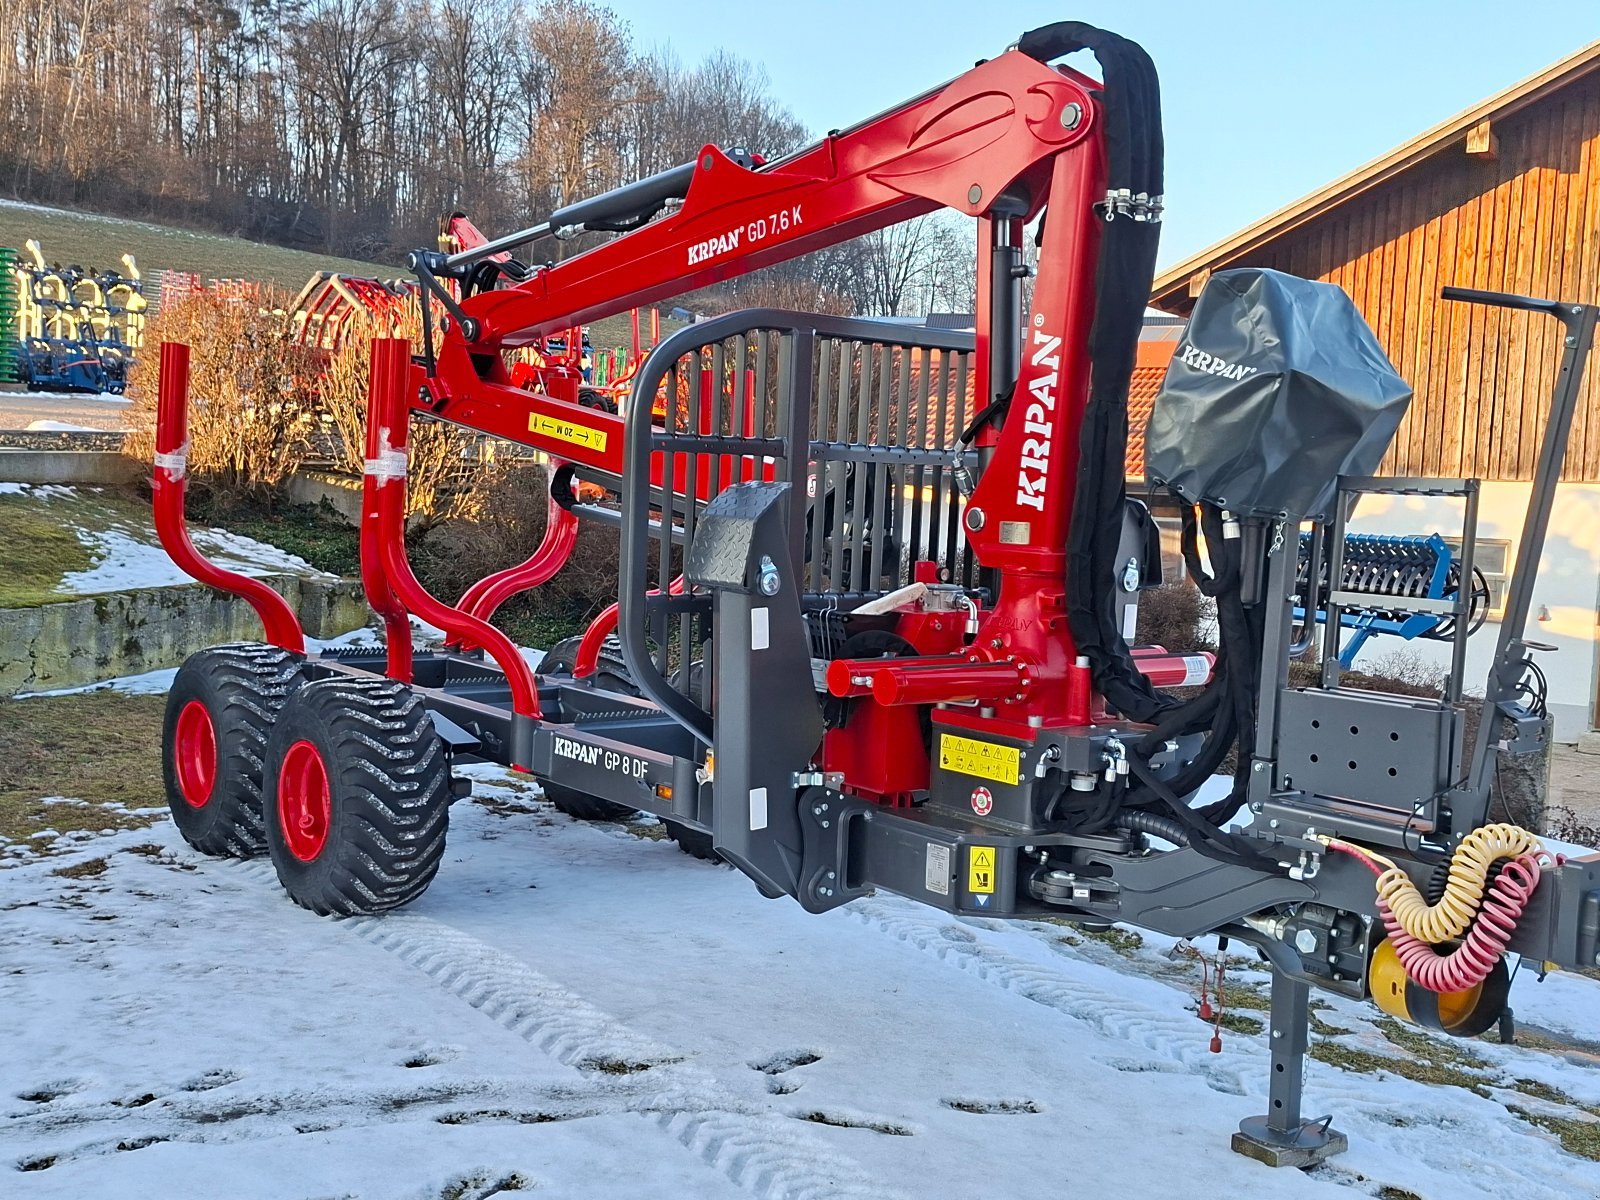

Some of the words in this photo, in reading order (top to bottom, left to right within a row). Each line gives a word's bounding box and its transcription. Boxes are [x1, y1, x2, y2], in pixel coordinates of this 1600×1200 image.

[747, 219, 767, 243] GD
[769, 209, 790, 235] 7,6
[792, 204, 803, 226] K
[556, 424, 563, 434] M
[564, 427, 573, 437] 20
[604, 751, 621, 771] GP
[622, 756, 630, 775] 8
[632, 759, 649, 779] DF
